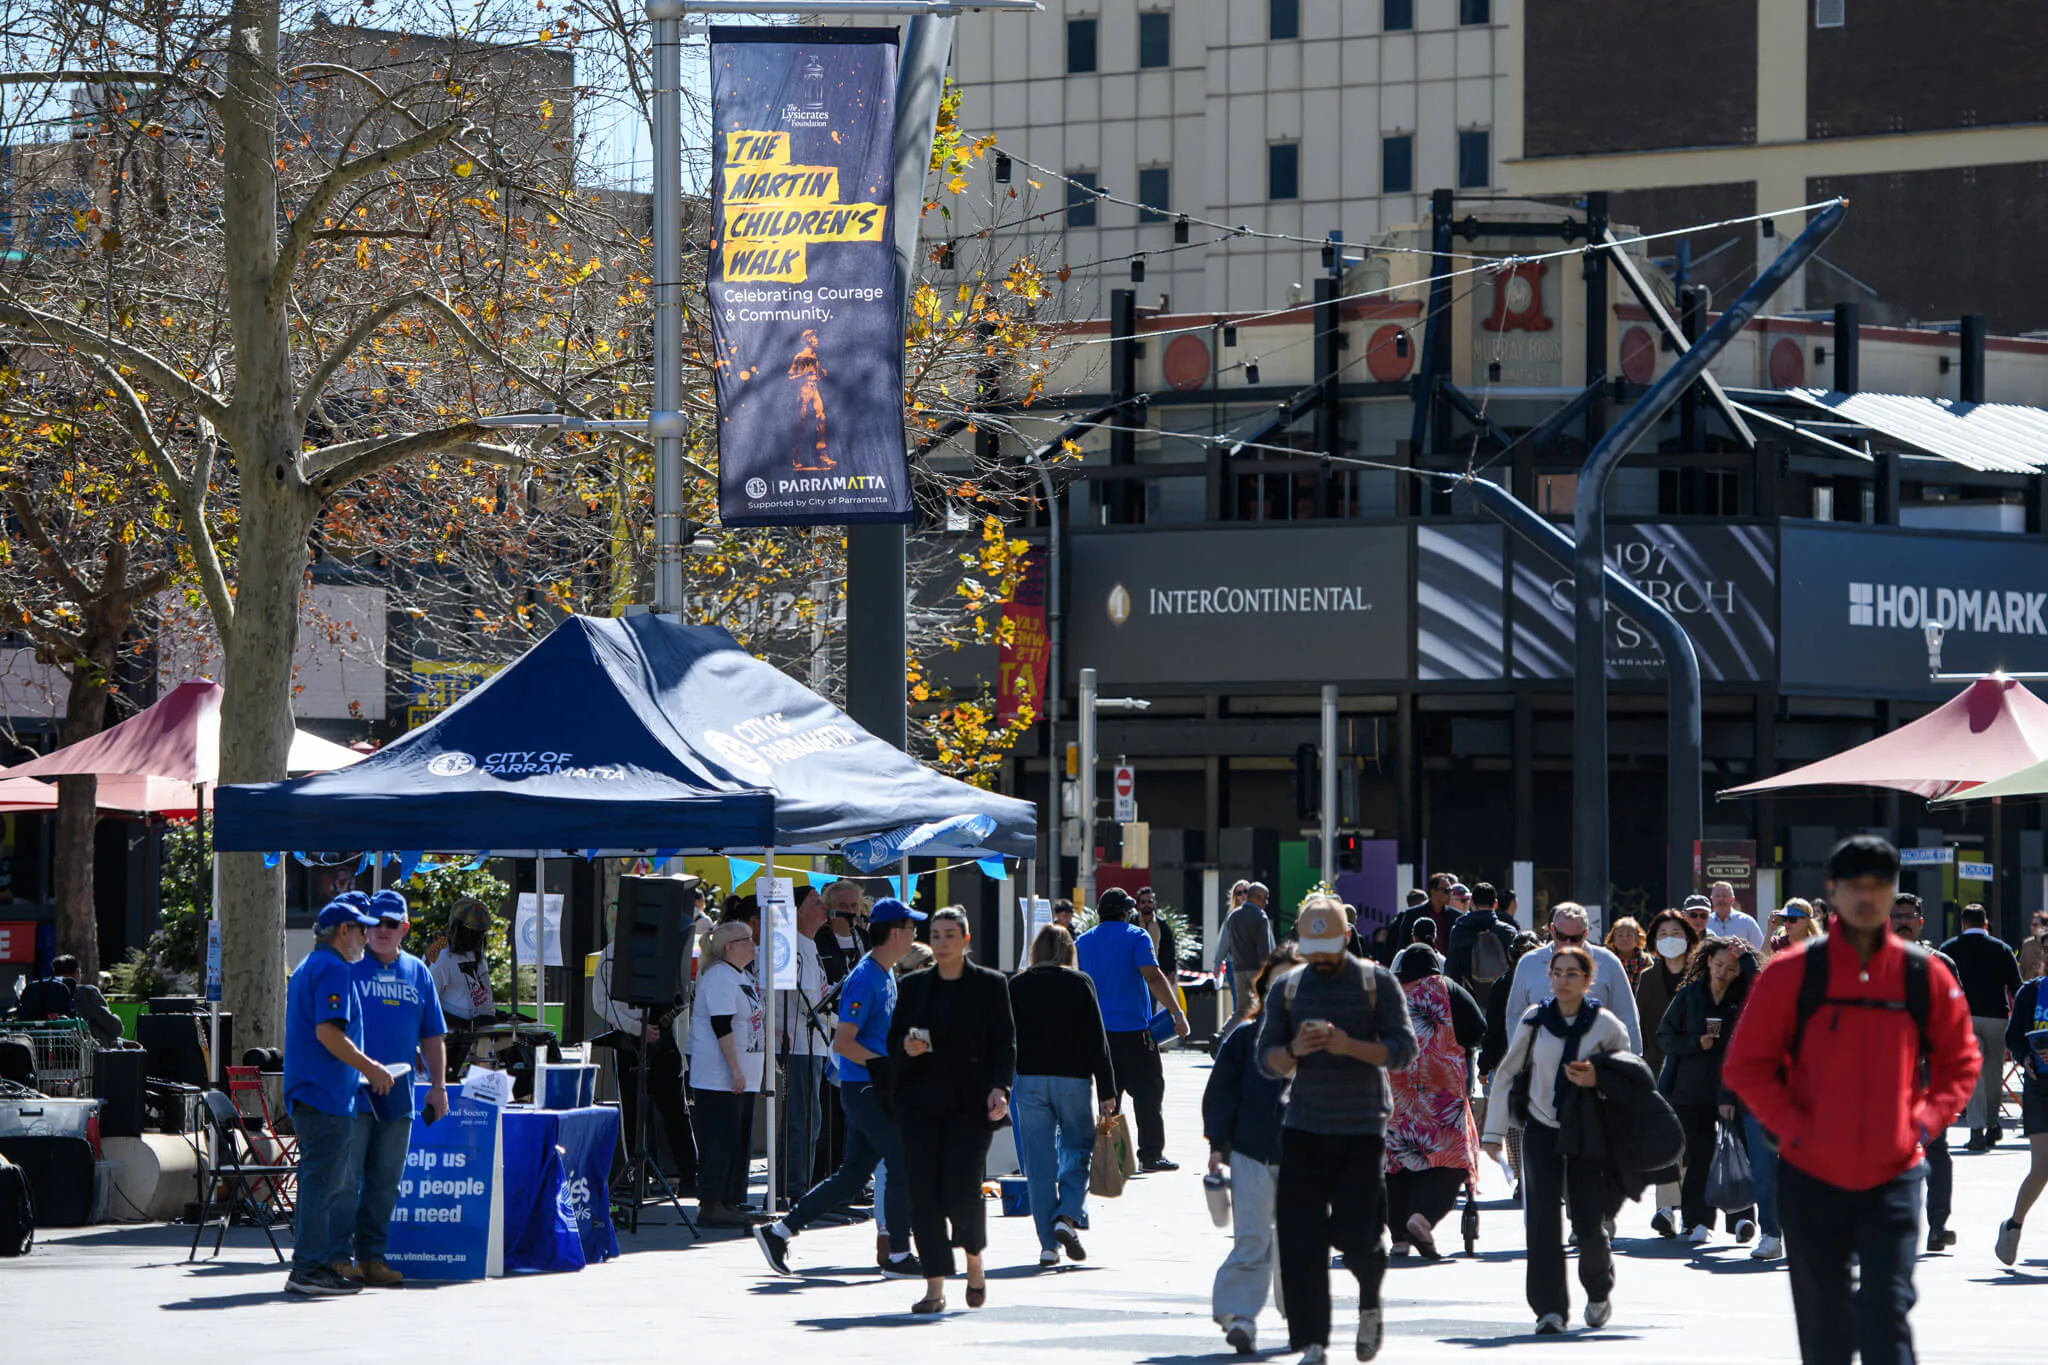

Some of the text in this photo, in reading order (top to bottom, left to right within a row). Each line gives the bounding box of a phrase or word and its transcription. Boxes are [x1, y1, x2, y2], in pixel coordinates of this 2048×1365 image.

[782, 109, 829, 122] Lysicrates
[787, 103, 798, 111] The
[732, 135, 781, 161] THE
[728, 172, 833, 200] MARTIN
[731, 208, 878, 238] CHILDREN'S
[729, 249, 800, 276] WALK
[725, 287, 883, 303] Celebrating Courage
[725, 306, 834, 322] & Community.
[779, 476, 886, 493] PARRAMATTA
[748, 496, 888, 509] Supported by City of Parramatta
[1613, 542, 1675, 575] 197
[1551, 579, 1736, 613] CRCH
[1877, 583, 2048, 635] HOLDMARK
[733, 717, 777, 744] CITY
[759, 724, 858, 765] PARRAMATTA
[485, 751, 572, 765] CITY OF
[479, 764, 625, 781] PARRAMATTA
[360, 980, 419, 1004] VINNIES
[463, 1108, 488, 1120] Society
[407, 1149, 466, 1171] elp us
[419, 1177, 485, 1199] people
[414, 1205, 462, 1222] need
[384, 1252, 466, 1264] www.vinnies.org.au
